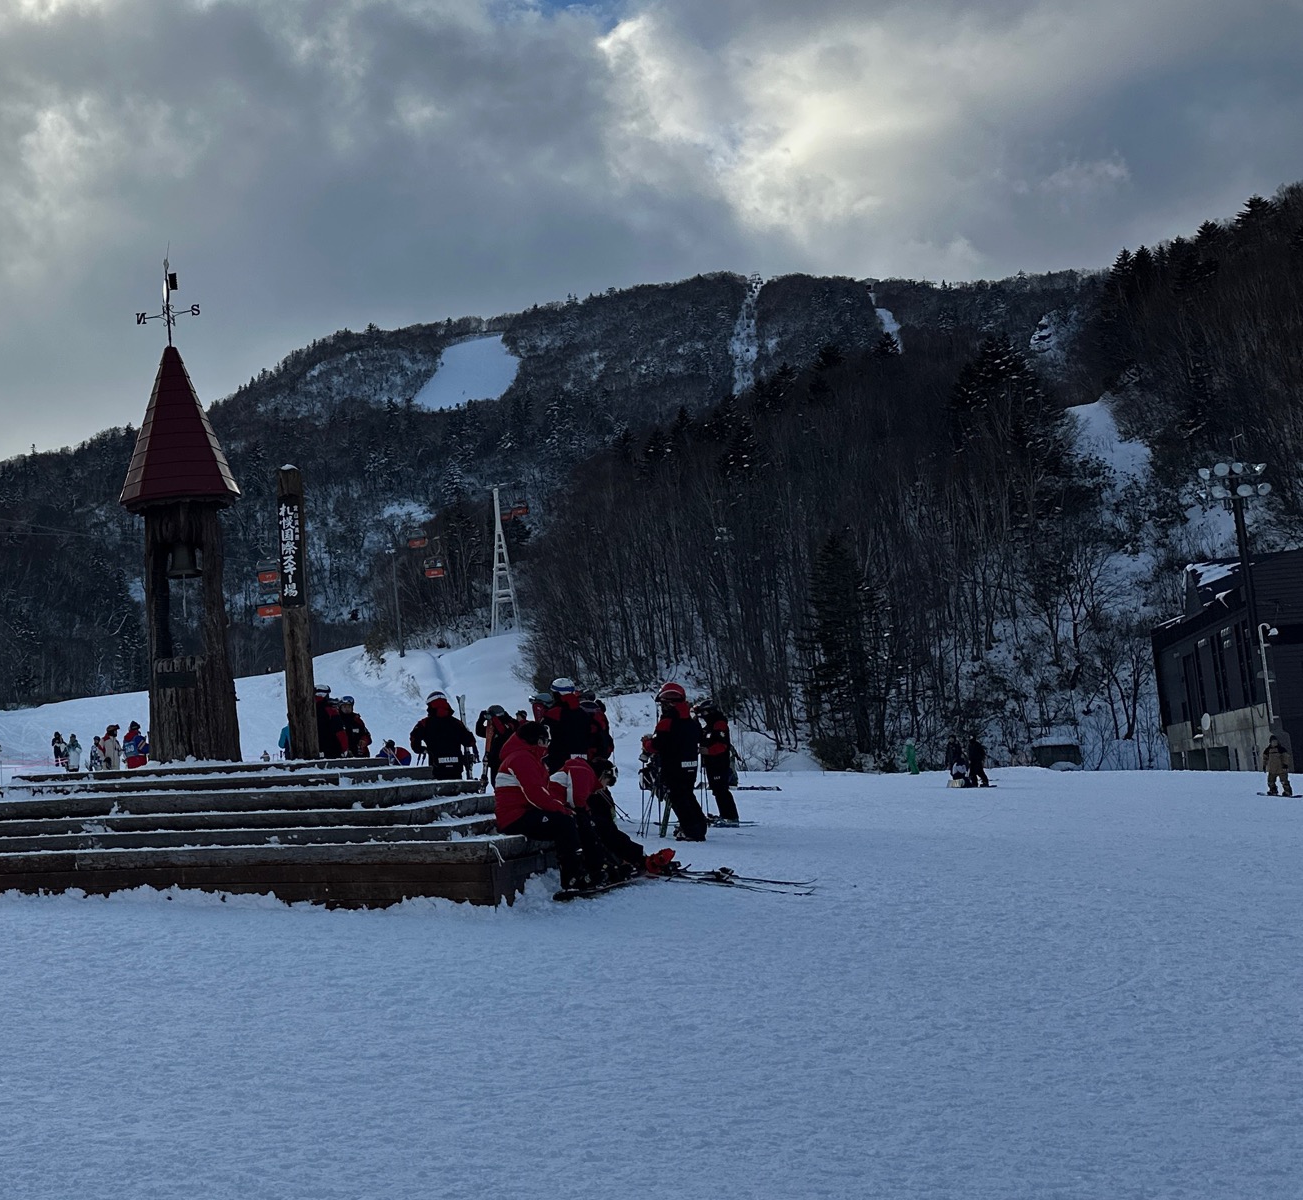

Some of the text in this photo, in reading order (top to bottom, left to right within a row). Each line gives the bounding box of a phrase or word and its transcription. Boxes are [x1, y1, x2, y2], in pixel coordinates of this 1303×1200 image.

[279, 502, 298, 597] 札幌国際スキー場
